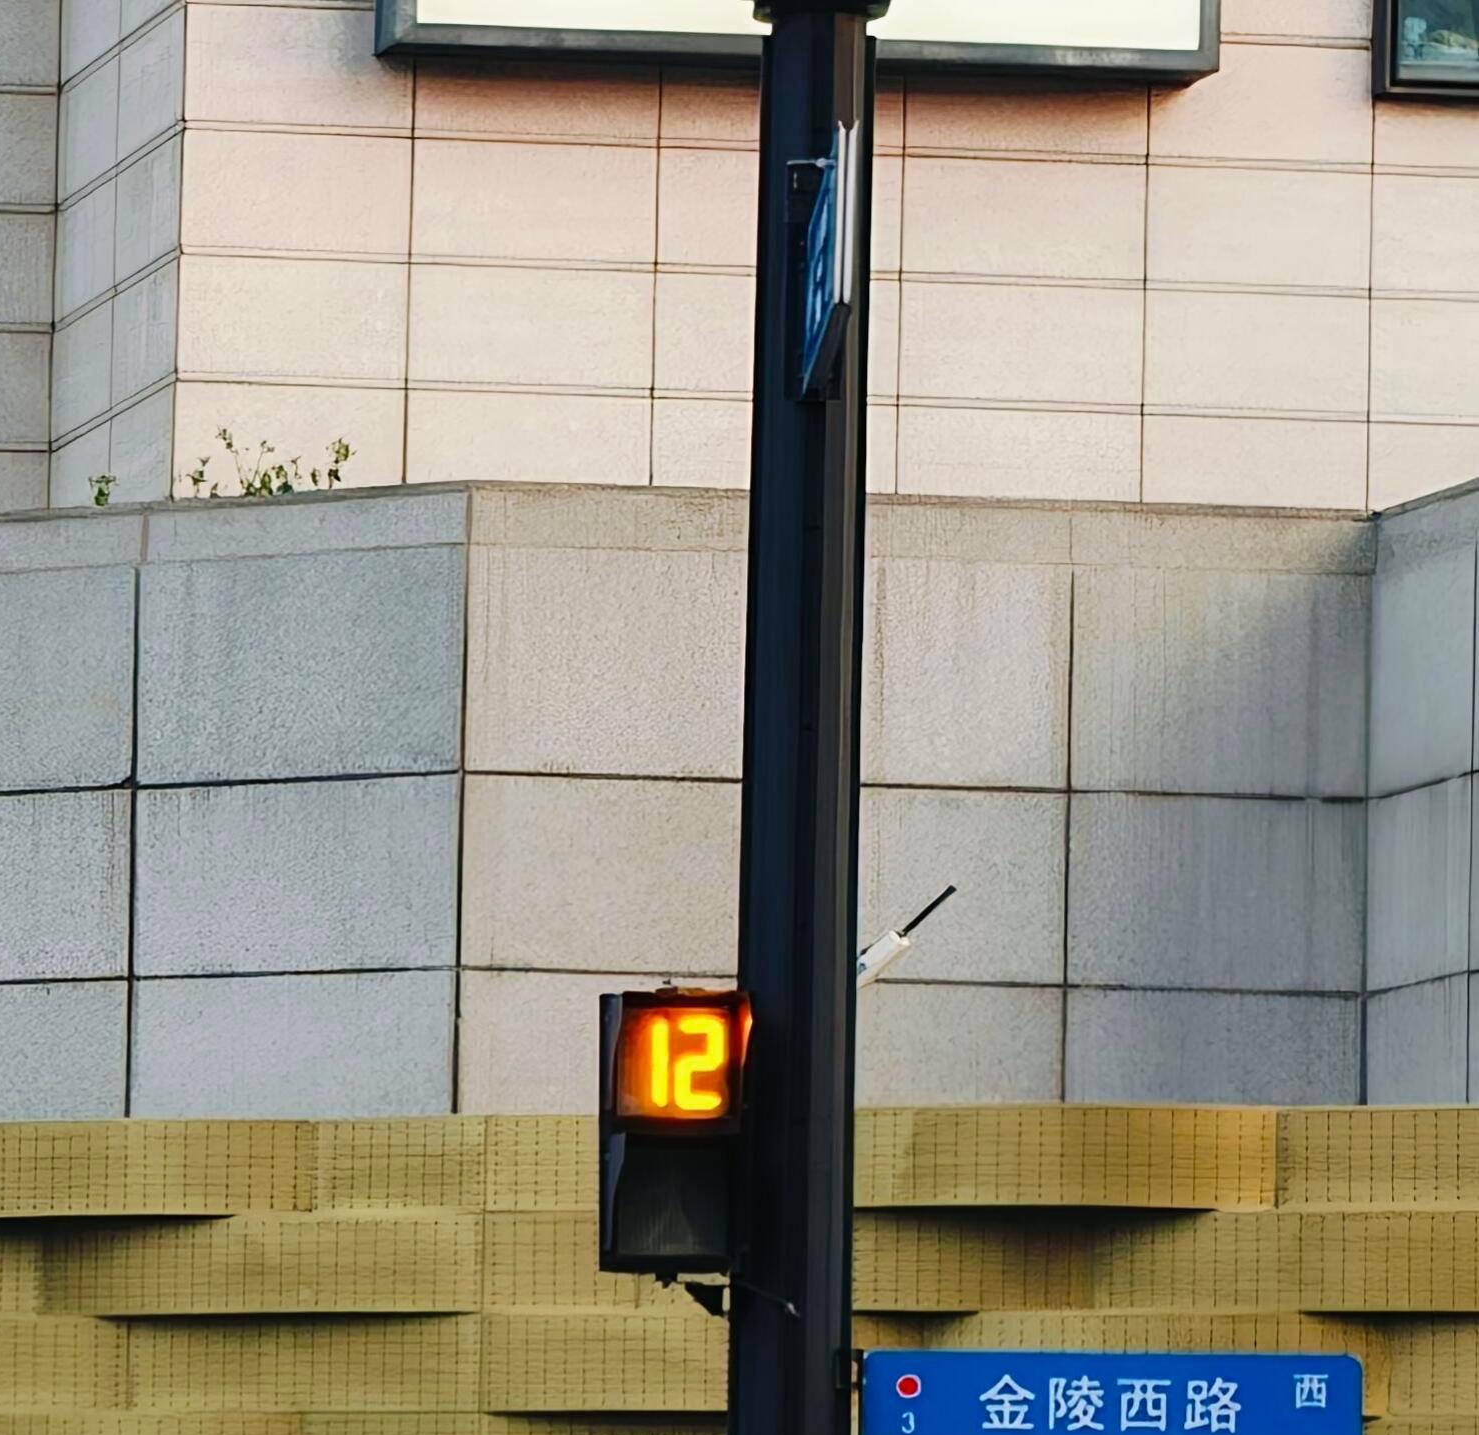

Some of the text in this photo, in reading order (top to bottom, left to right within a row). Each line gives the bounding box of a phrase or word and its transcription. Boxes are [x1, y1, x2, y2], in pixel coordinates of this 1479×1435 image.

[651, 1014, 725, 1110] 12
[979, 1374, 1241, 1433] 金陵西路
[1293, 1374, 1329, 1409] 西
